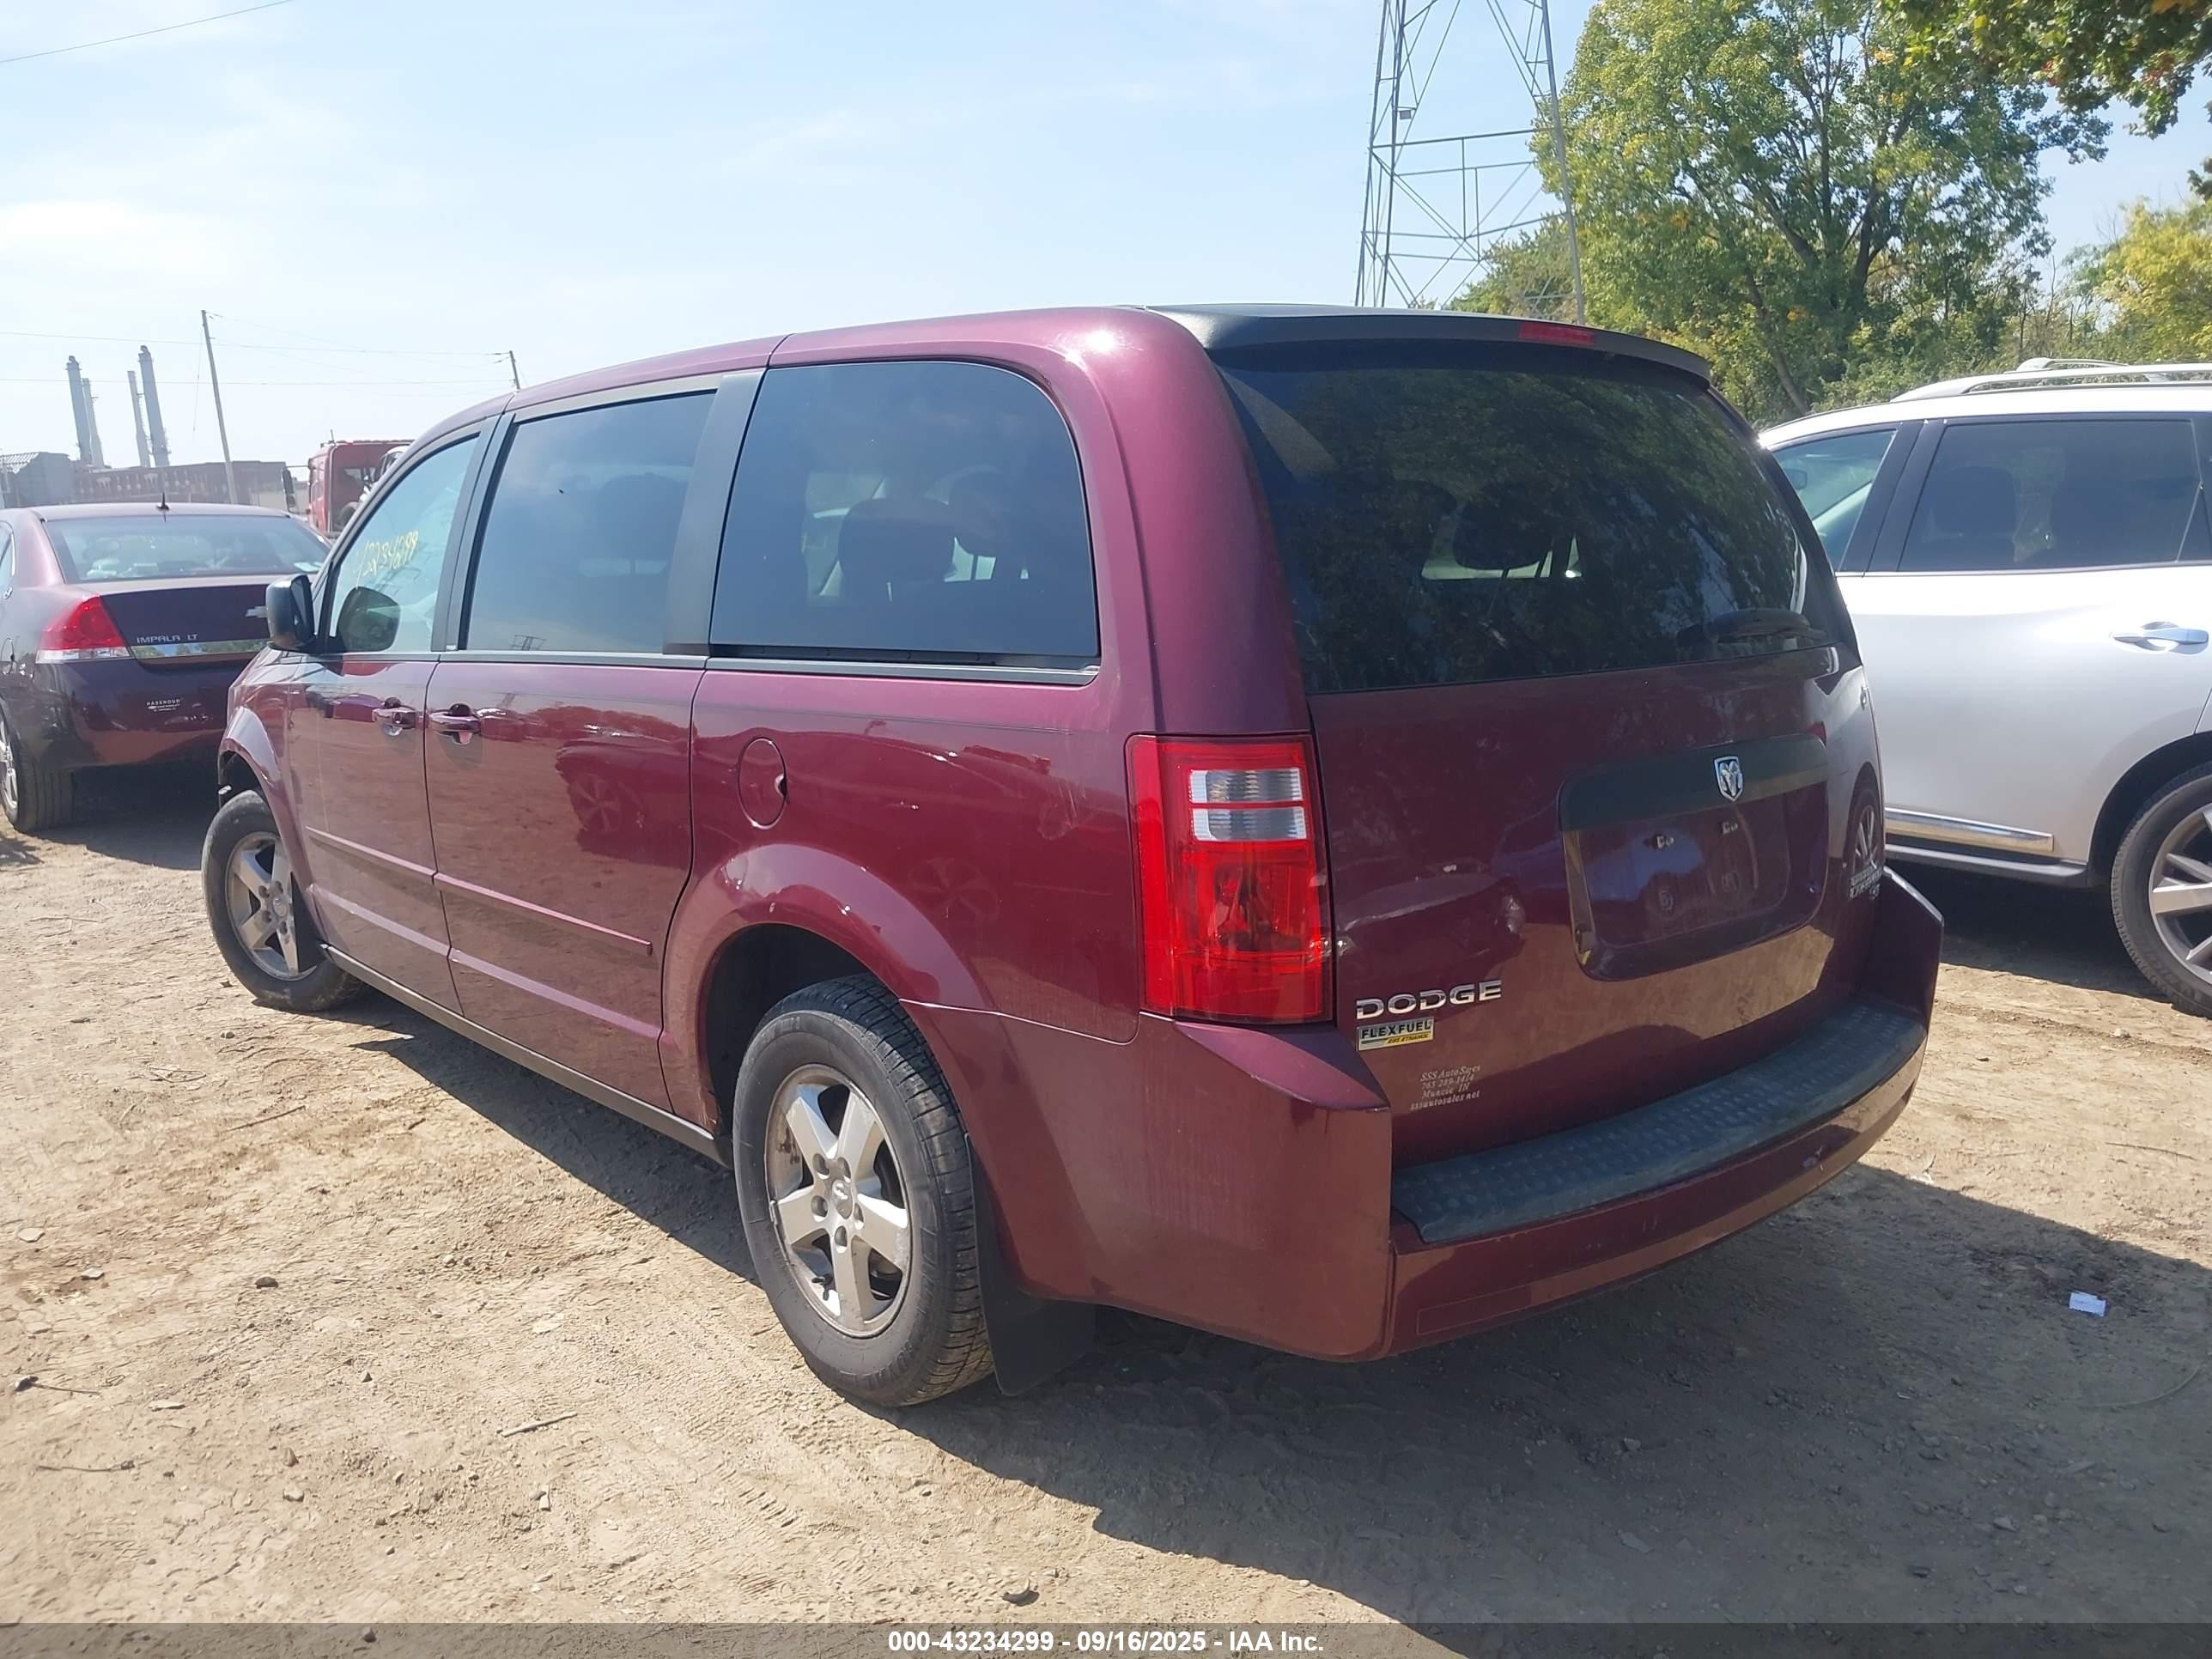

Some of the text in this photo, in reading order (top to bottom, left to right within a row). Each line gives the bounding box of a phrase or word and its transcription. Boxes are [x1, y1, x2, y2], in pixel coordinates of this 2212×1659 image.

[137, 634, 180, 643] IMPALA
[1356, 980, 1503, 1019] DODGE
[1360, 1019, 1431, 1039] FLEXFUEL
